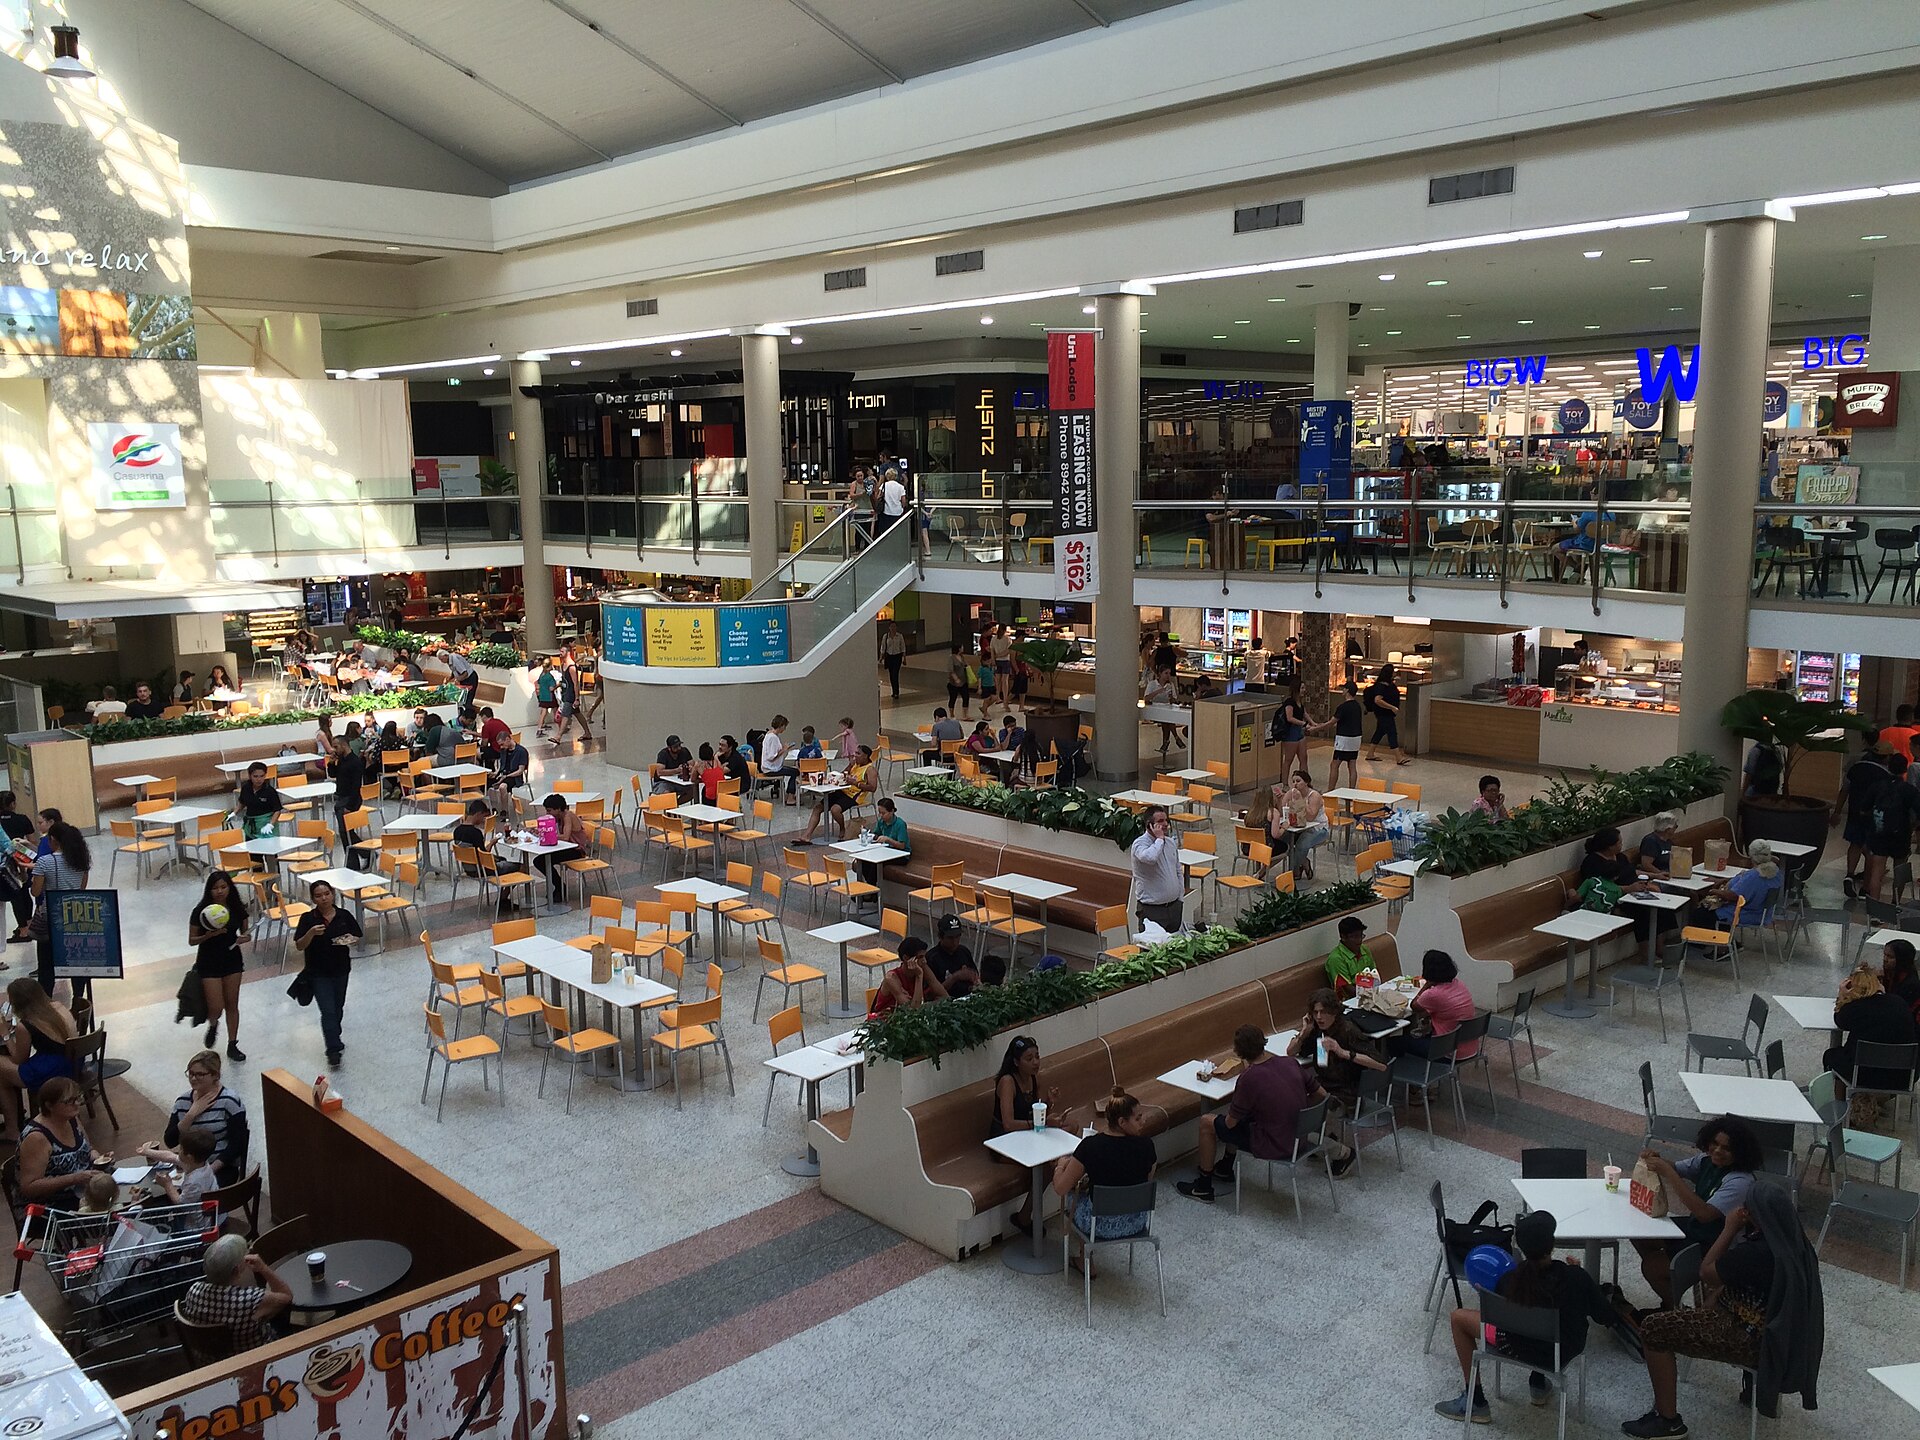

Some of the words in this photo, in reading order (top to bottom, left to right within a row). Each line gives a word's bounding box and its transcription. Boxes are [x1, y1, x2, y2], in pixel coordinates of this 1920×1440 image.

[66, 245, 149, 272] relax
[1803, 333, 1865, 370] BIG
[1635, 344, 1701, 403] W
[1847, 385, 1885, 395] MUFFIN
[847, 391, 886, 409] train
[1631, 402, 1652, 410] TOY
[1764, 396, 1780, 405] OY
[1849, 400, 1880, 410] BREAK
[975, 389, 994, 456] zushi
[1629, 410, 1653, 418] SALE
[1059, 416, 1068, 459] Phone
[1072, 415, 1086, 485] LEASING
[113, 471, 164, 481] Casuarina
[1060, 462, 1070, 495] 8942
[1808, 492, 1842, 504] Days
[1061, 498, 1070, 529] 0706
[1074, 489, 1087, 528] NOW
[1065, 540, 1085, 593] $162
[625, 617, 631, 626] 6
[659, 619, 665, 627] 7
[693, 619, 699, 627] 8
[734, 621, 742, 630] 9
[767, 619, 778, 628] 10
[62, 900, 103, 925] FREE
[371, 1292, 527, 1372] Coffee
